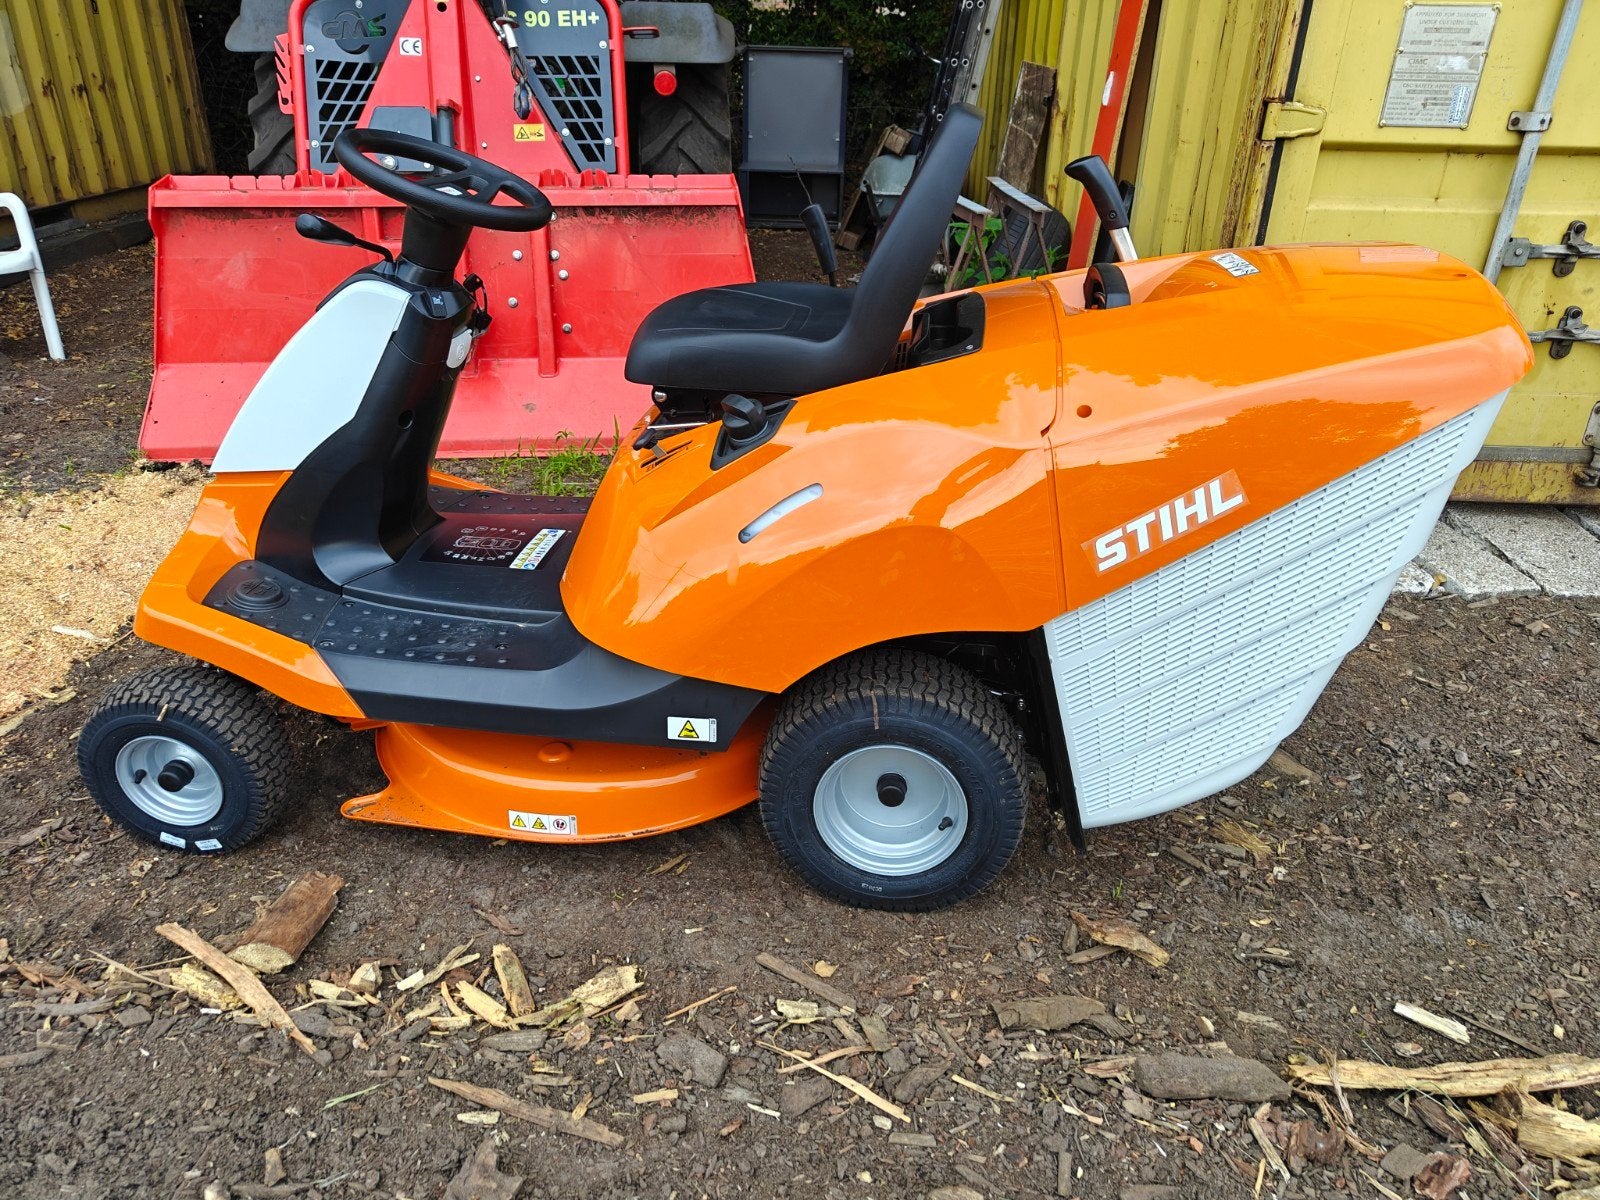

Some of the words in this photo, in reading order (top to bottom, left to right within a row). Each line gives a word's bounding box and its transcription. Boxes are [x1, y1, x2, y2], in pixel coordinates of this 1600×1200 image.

[524, 10, 550, 27] 90
[557, 10, 600, 27] EH+
[401, 39, 421, 54] CE
[1095, 478, 1244, 572] STIHL
